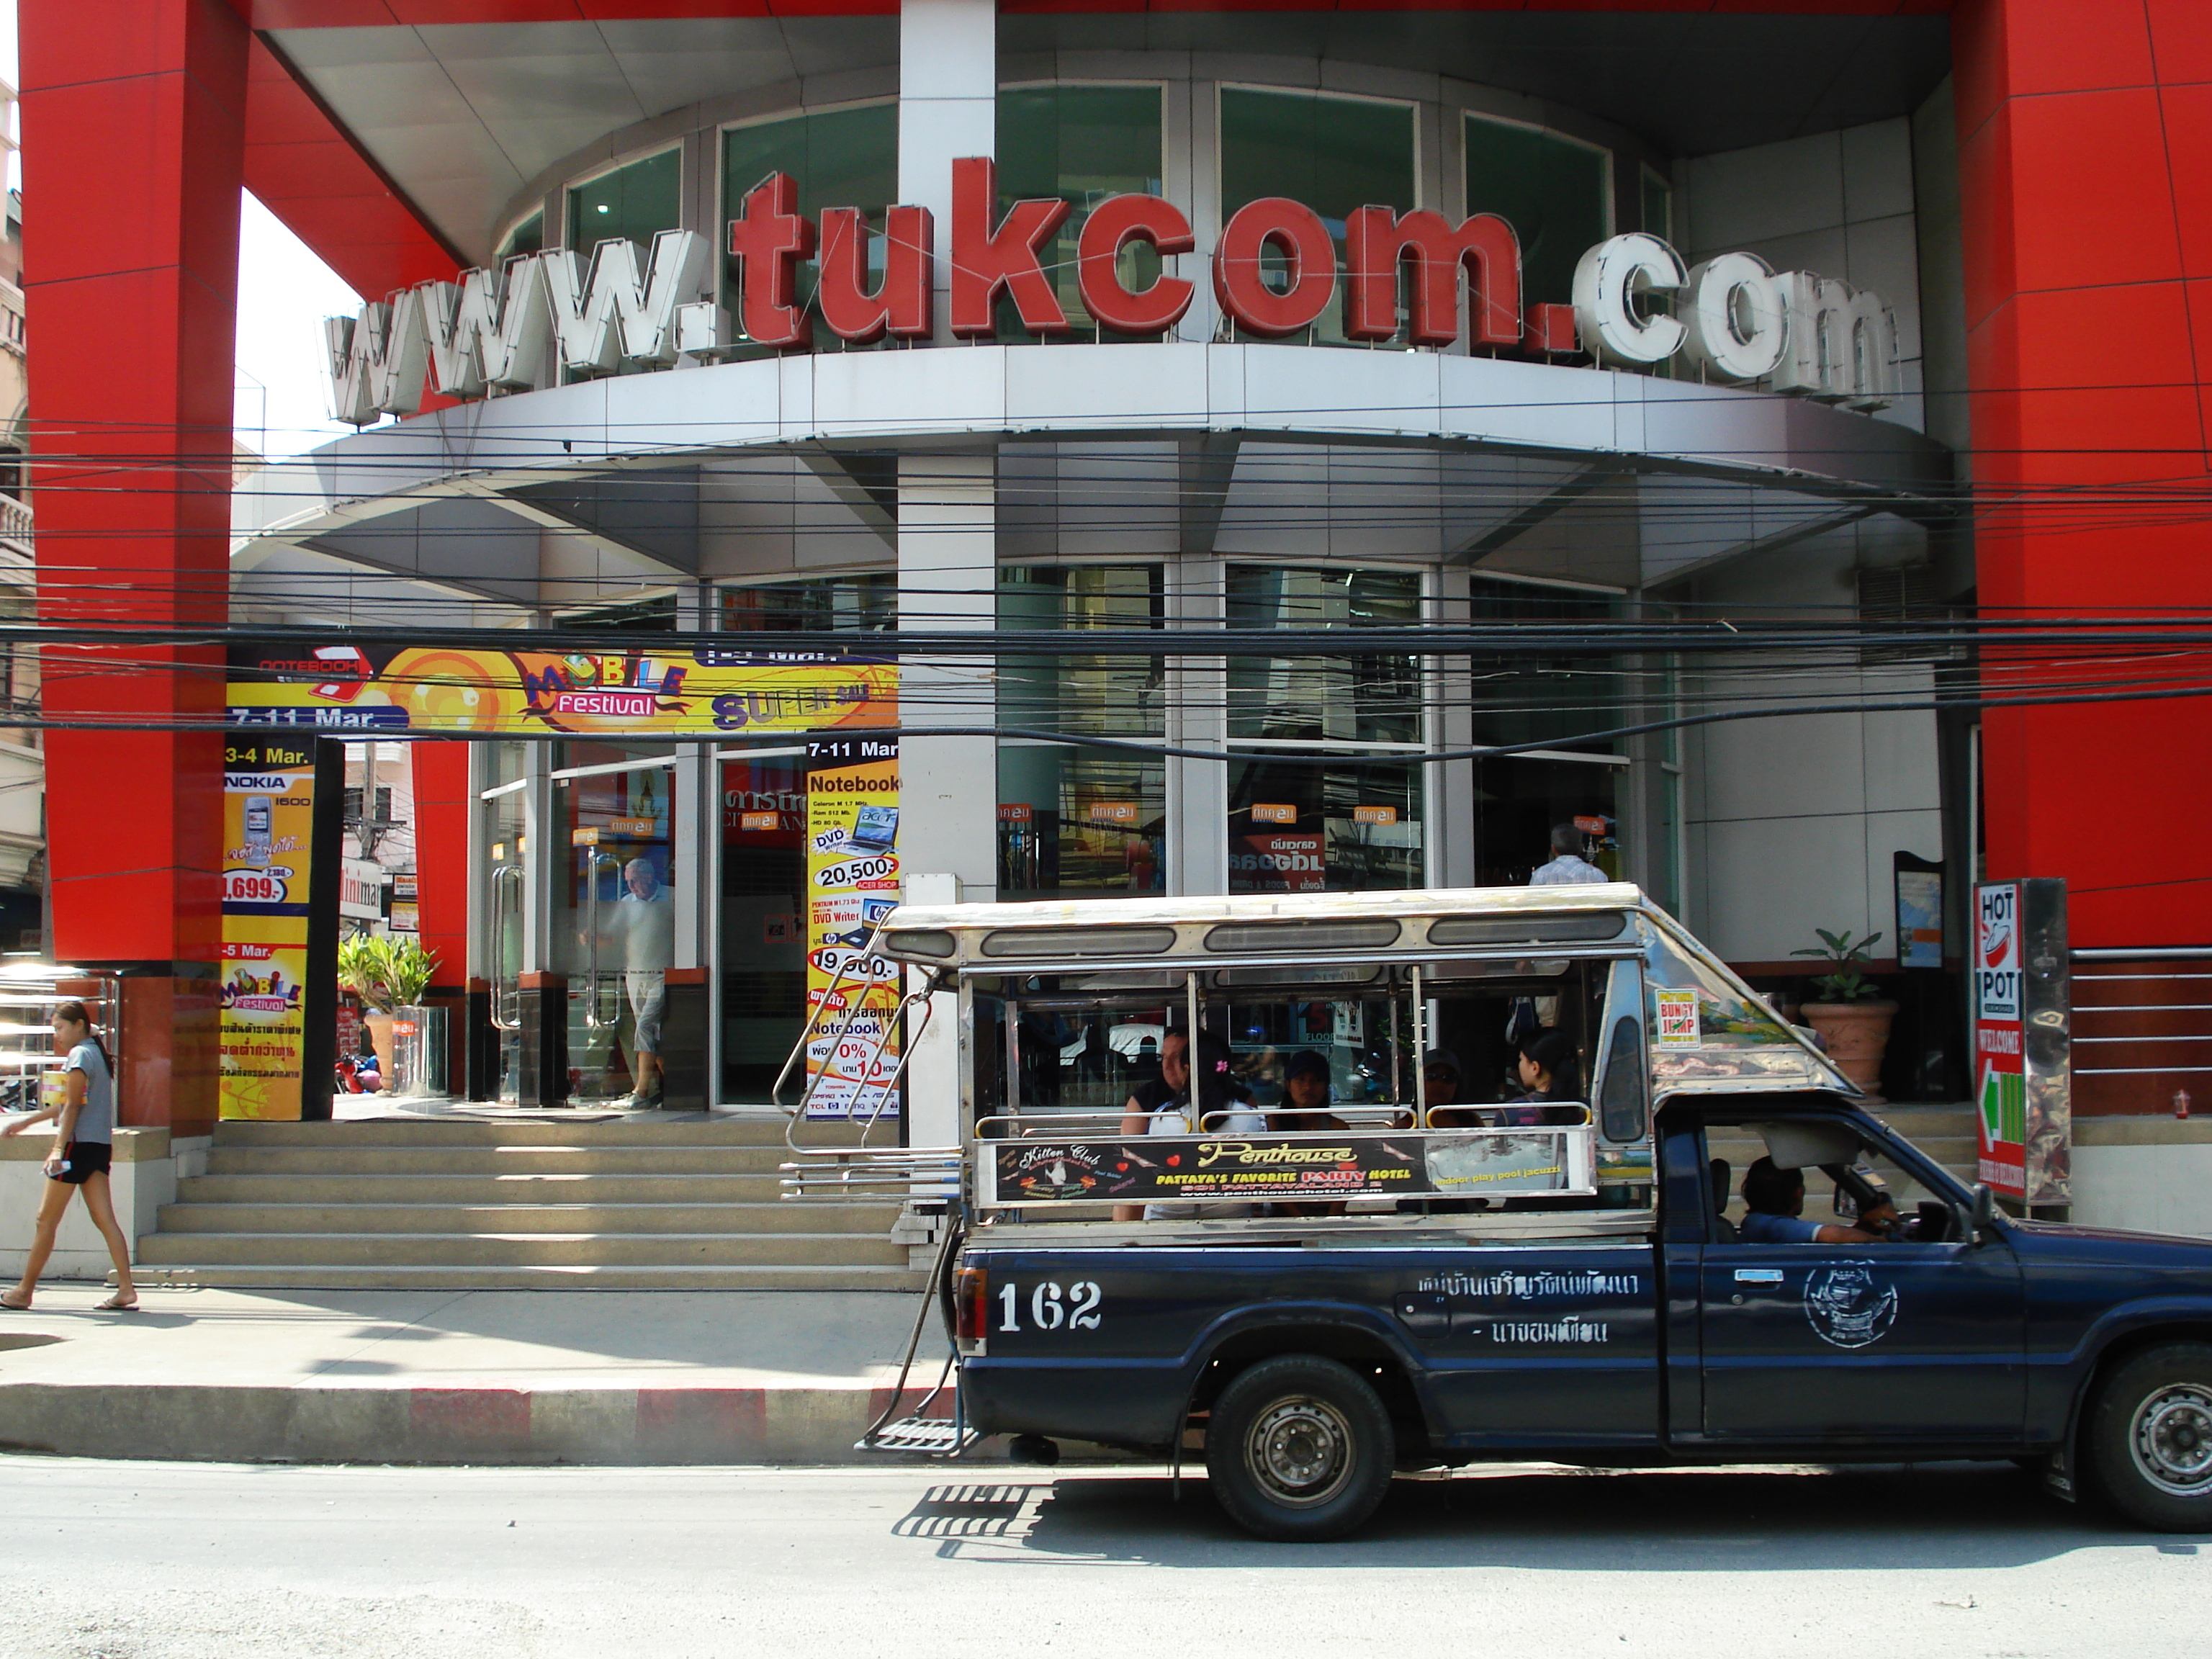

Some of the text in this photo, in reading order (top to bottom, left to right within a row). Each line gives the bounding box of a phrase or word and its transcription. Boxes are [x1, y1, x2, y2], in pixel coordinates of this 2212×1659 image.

[559, 693, 652, 716] Festival
[712, 686, 830, 730] SUPER
[233, 708, 380, 728] 7-11 Mar.
[225, 748, 308, 764] 3-4 Mar.
[809, 742, 850, 757] 7-11
[225, 777, 286, 788] NOKIA
[810, 776, 899, 792] Notebook
[276, 797, 310, 806] 1600
[817, 830, 844, 848] DVD
[1982, 893, 2014, 920] HOT
[814, 911, 860, 925] DVD Writer
[241, 945, 271, 957] Mar.
[1984, 971, 2015, 999] POT
[235, 997, 284, 1011] Festival
[1660, 1004, 1694, 1017] BUNGY
[839, 1043, 867, 1058] 0%
[1979, 1029, 2020, 1055] WELCOME
[1019, 1146, 1065, 1169] Kitten
[1070, 1144, 1102, 1166] Club
[1197, 1141, 1358, 1168] Penthouse
[1156, 1169, 1411, 1185] PATTAYA'S FAVORITE PARTY HOTEL
[1471, 1173, 1495, 1184] play
[1497, 1169, 1521, 1181] pool
[1522, 1165, 1561, 1179] jacuzzi
[999, 1282, 1102, 1331] 162
